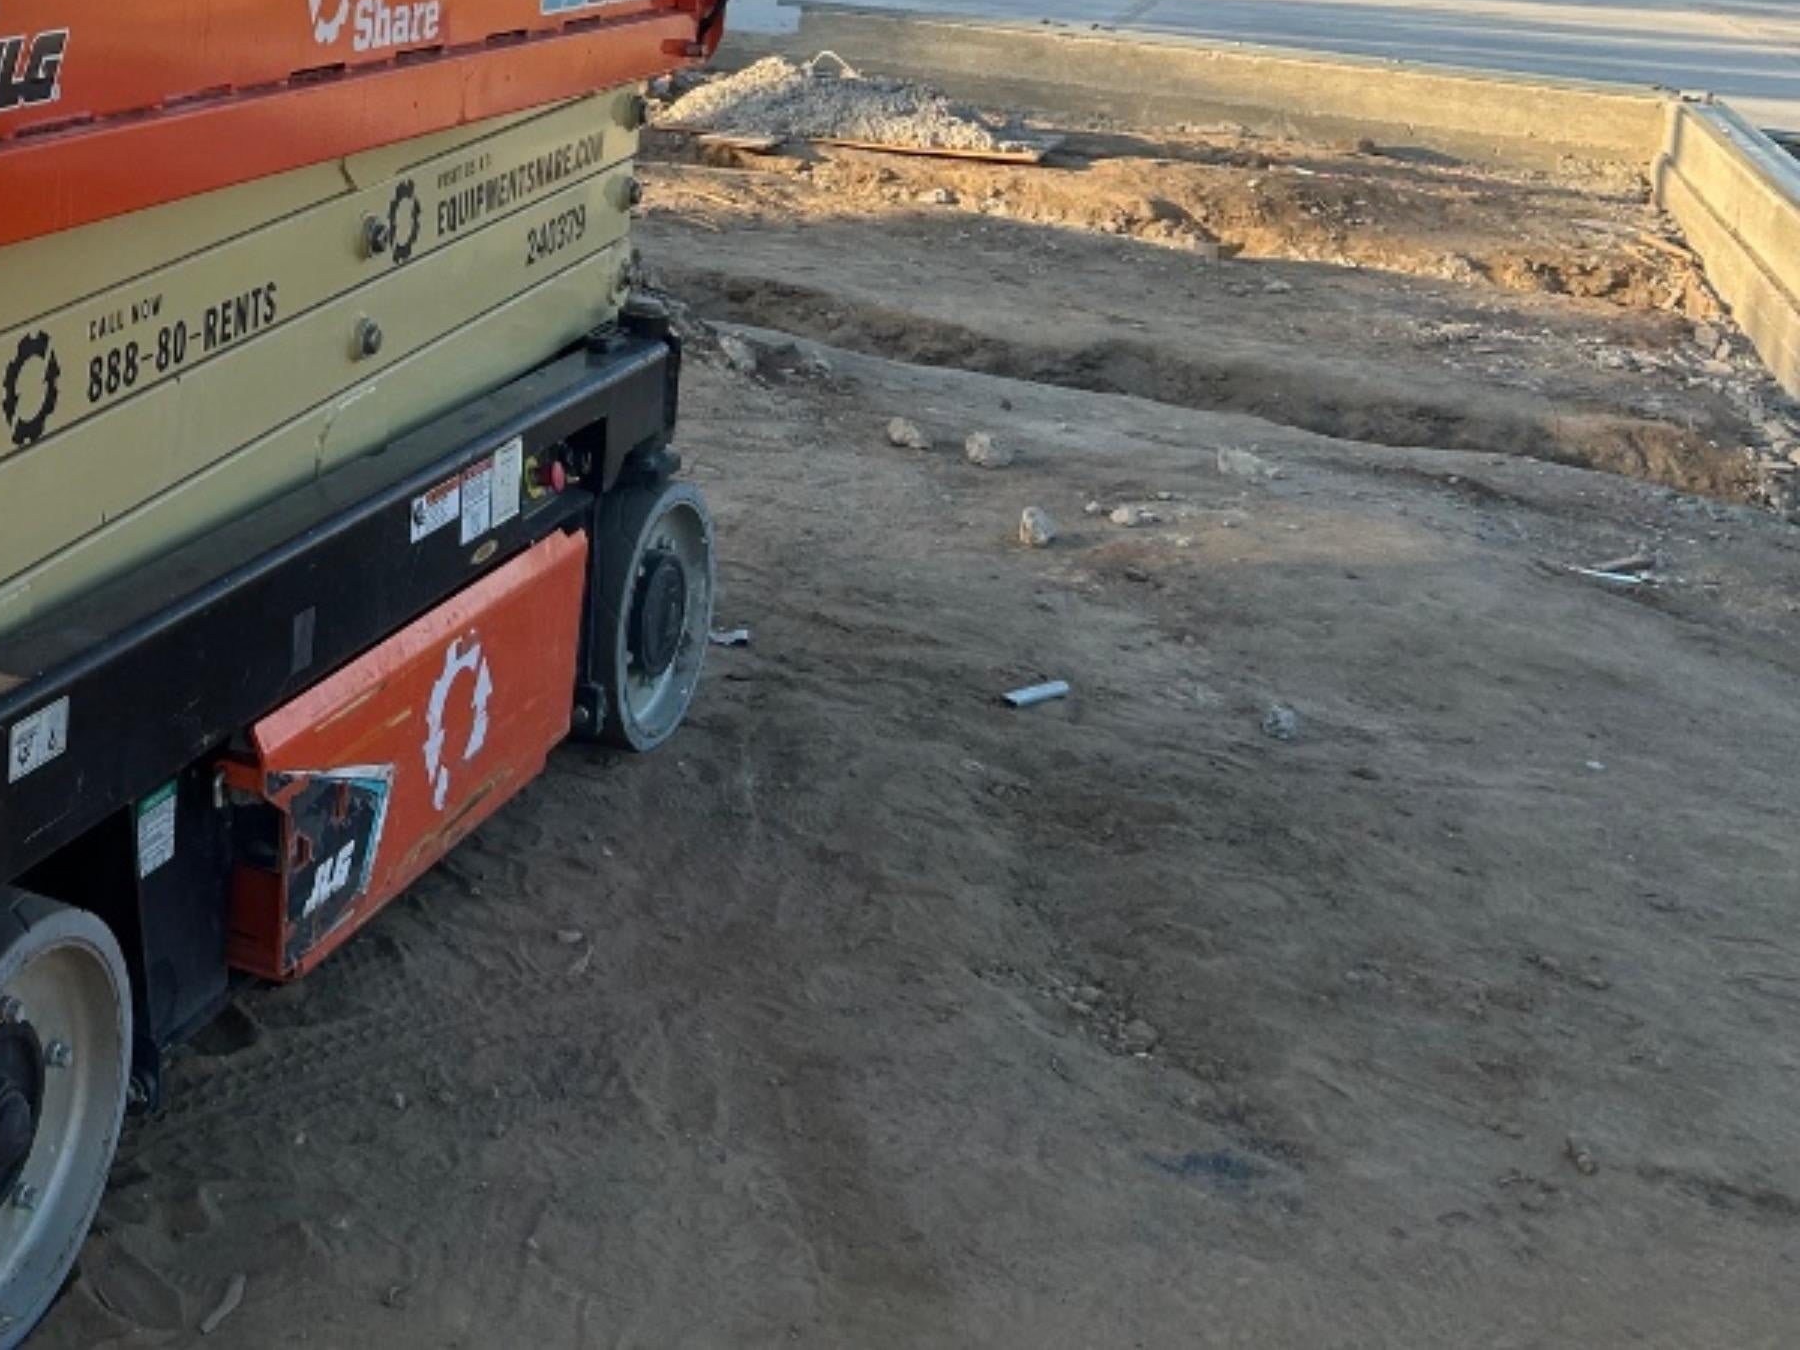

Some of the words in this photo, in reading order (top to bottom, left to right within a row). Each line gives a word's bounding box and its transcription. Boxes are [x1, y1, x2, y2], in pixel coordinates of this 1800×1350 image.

[88, 281, 277, 402] 888-80-RENTS
[89, 311, 124, 342] CALL
[131, 294, 162, 325] NOW
[302, 839, 356, 919] JLG
